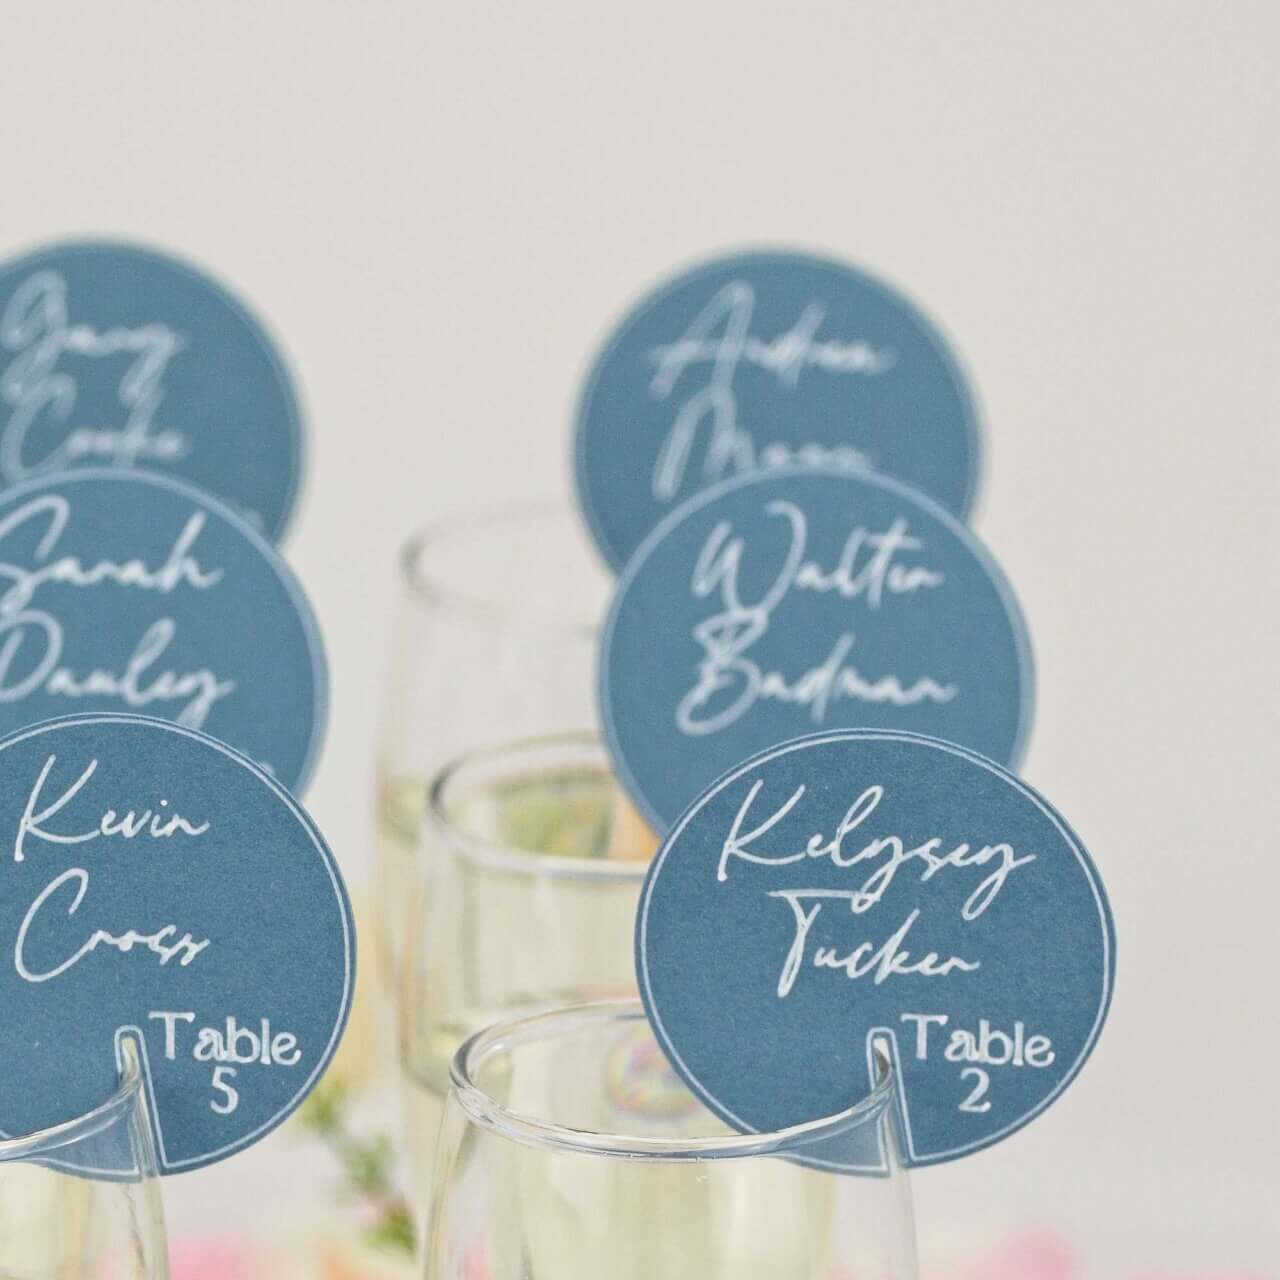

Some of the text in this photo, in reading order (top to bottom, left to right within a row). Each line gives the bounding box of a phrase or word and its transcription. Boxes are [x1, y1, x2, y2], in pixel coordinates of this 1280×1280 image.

[647, 279, 901, 400] Andrea
[690, 498, 946, 615] Walter
[13, 753, 211, 862] Kevin
[13, 867, 211, 983] Cross
[764, 888, 981, 999] Tucker
[147, 1010, 303, 1067] Table
[209, 1065, 240, 1115] 5
[899, 1012, 1056, 1068] Table
[957, 1066, 992, 1113] 2
